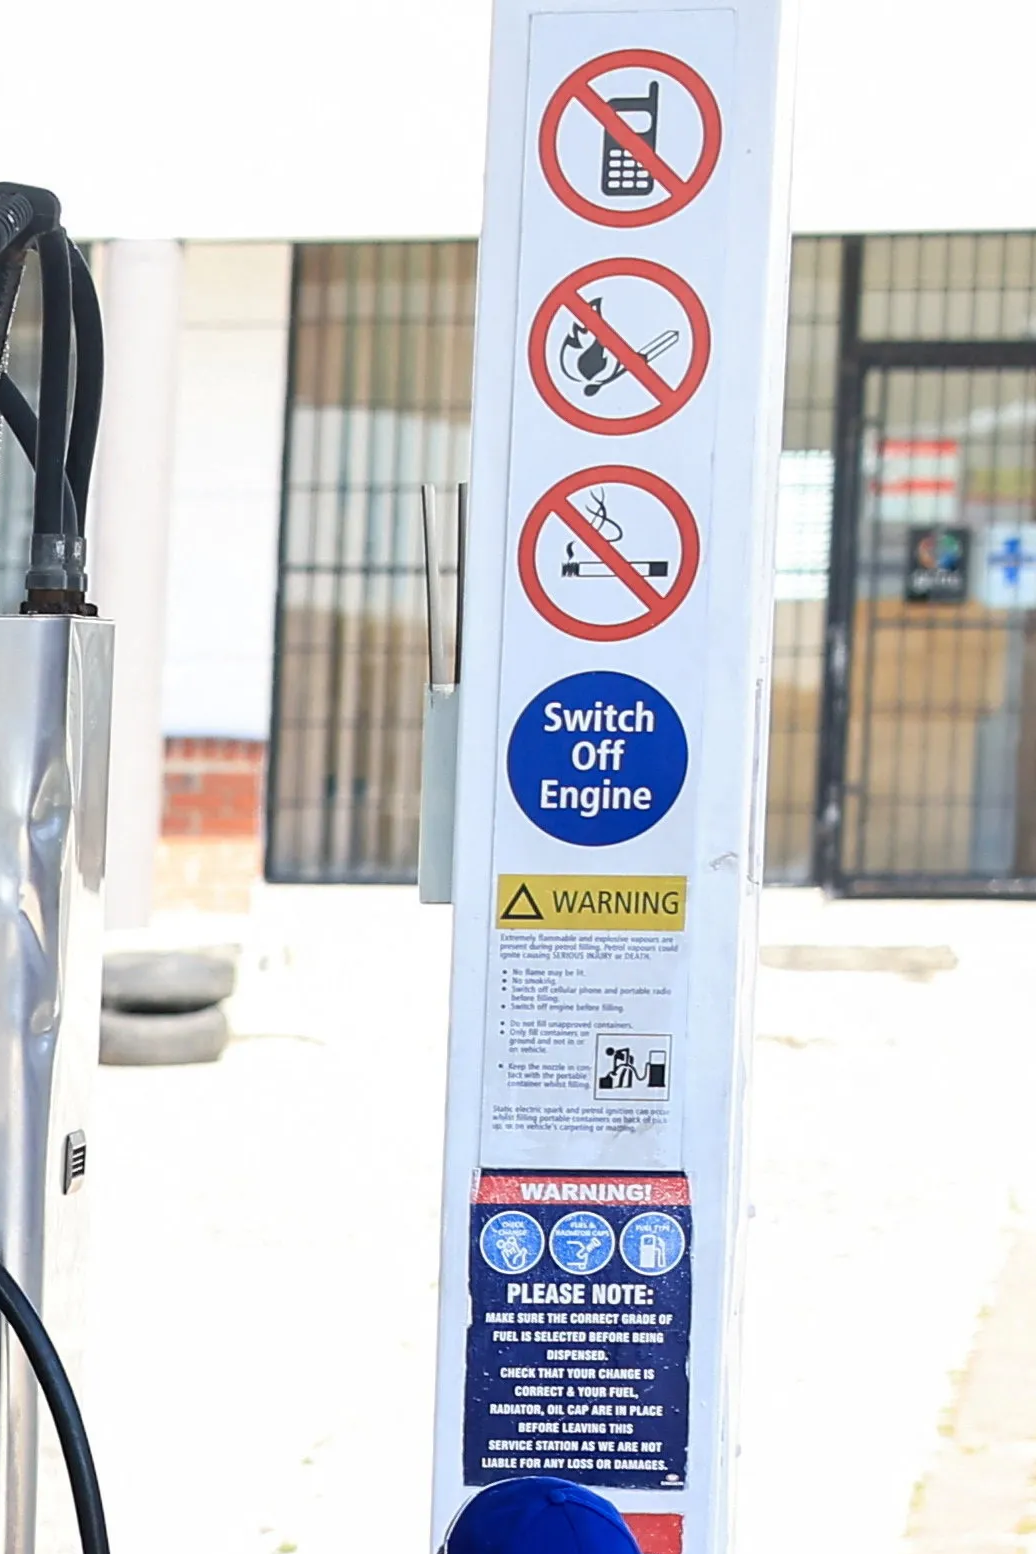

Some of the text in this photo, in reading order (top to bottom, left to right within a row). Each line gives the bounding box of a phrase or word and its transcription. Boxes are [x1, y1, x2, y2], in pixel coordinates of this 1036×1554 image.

[544, 701, 654, 732] Switch
[571, 739, 626, 771] Off
[540, 779, 652, 818] Engine
[552, 890, 679, 915] WARNING
[521, 1183, 654, 1202] WARNING!
[636, 1224, 654, 1232] FUEL
[508, 1283, 654, 1305] PLEASE NOTE:
[486, 1312, 673, 1325] MAKE SURE THE CORRECT GRADE OF
[493, 1331, 664, 1343] FUEL IS SELECTED BEFORE BEING
[546, 1349, 608, 1361] DISPENSED.
[500, 1367, 654, 1379] CHECK THAT YOUR CHANGE IS
[514, 1386, 638, 1399] CORRECT & YOUR FUEL,
[490, 1403, 663, 1417] RADIATOR, OIL CAP ARE IN PLACE
[518, 1422, 633, 1434] BEFORE LEAVING THIS
[488, 1440, 662, 1452] SERVICE STATION AS WE ARE NOT
[482, 1458, 668, 1470] LIABLE FOR ANY LOSS OR DAMAGES.
